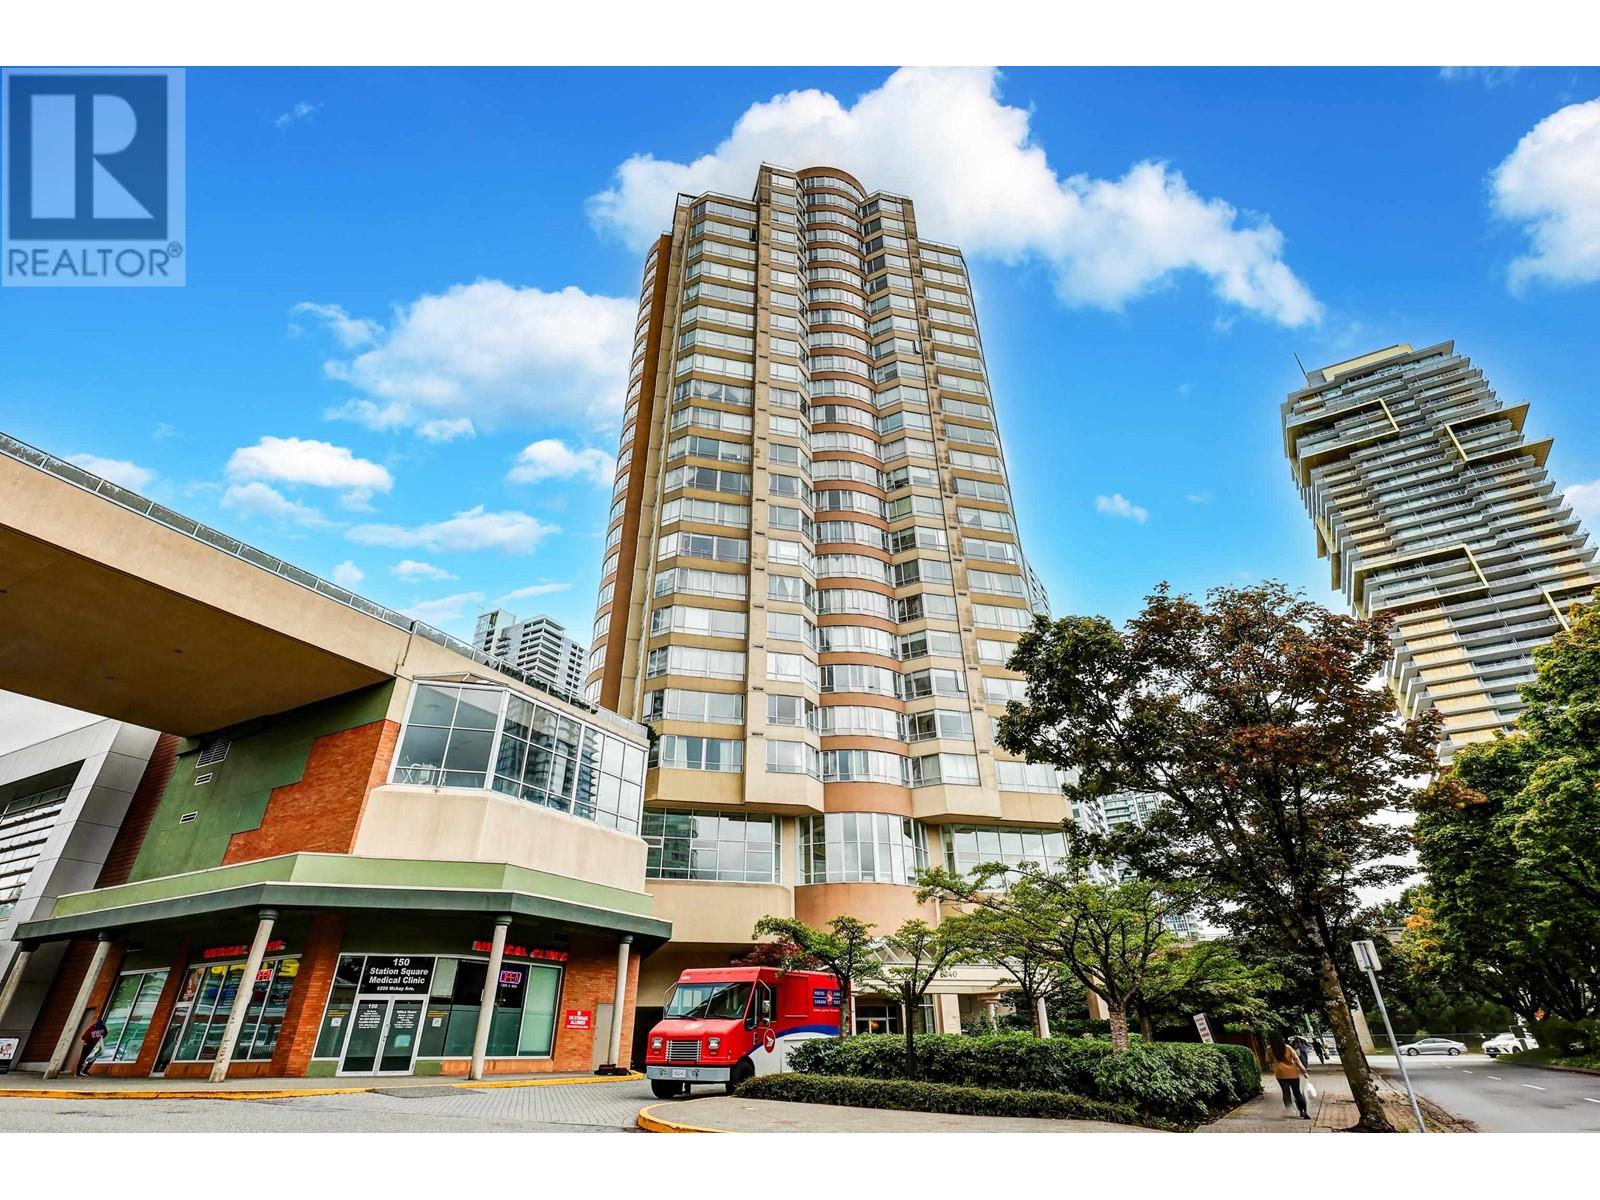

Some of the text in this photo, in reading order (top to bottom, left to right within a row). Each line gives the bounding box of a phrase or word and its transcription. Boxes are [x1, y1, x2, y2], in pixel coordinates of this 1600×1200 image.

[530, 949, 568, 961] CLINIC
[393, 958, 410, 966] 150
[369, 967, 429, 977] Station Square
[368, 976, 425, 984] Medical Clinic
